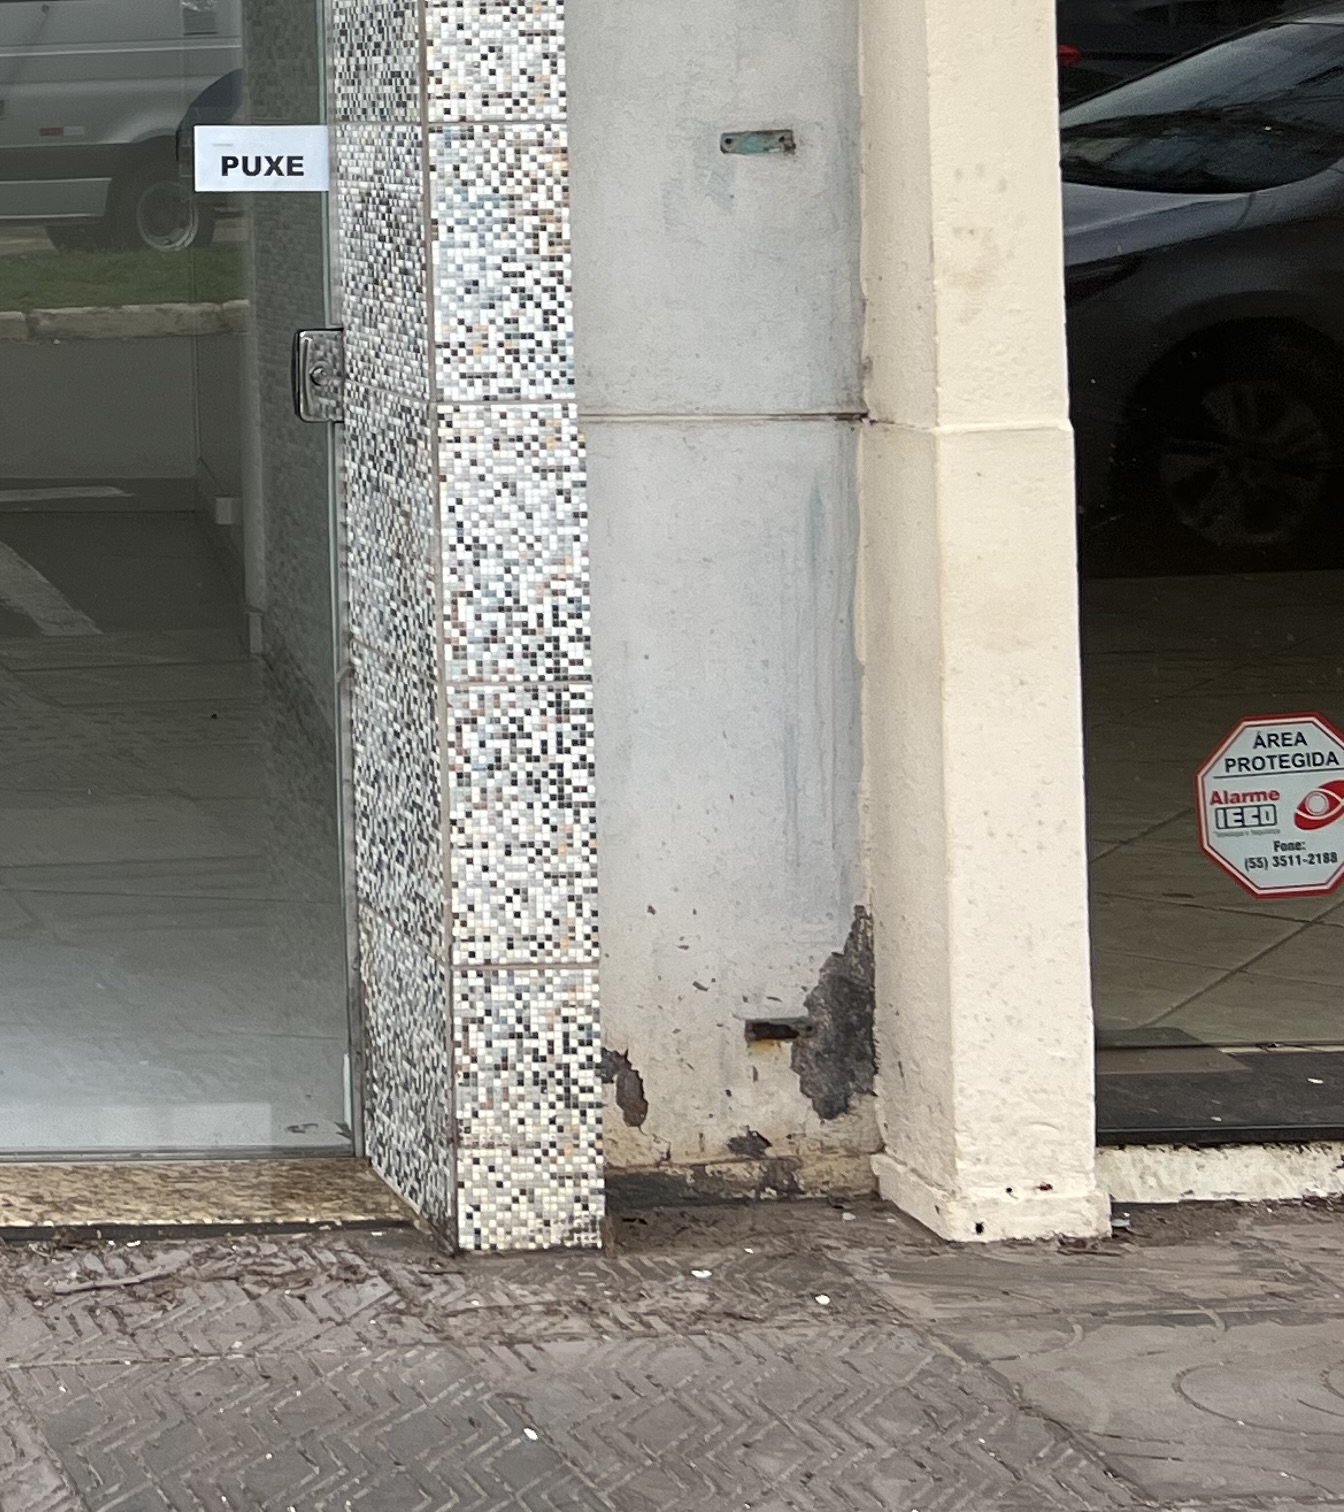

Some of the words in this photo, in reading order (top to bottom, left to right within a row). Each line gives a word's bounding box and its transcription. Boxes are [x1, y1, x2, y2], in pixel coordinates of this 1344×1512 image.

[221, 155, 305, 177] PUXE
[1253, 731, 1308, 749] ÁREA
[1225, 751, 1339, 773] PROTEGIDA
[1210, 790, 1280, 806] Alarme
[1273, 840, 1306, 852] Fone:
[1271, 851, 1338, 868] 3511-2188
